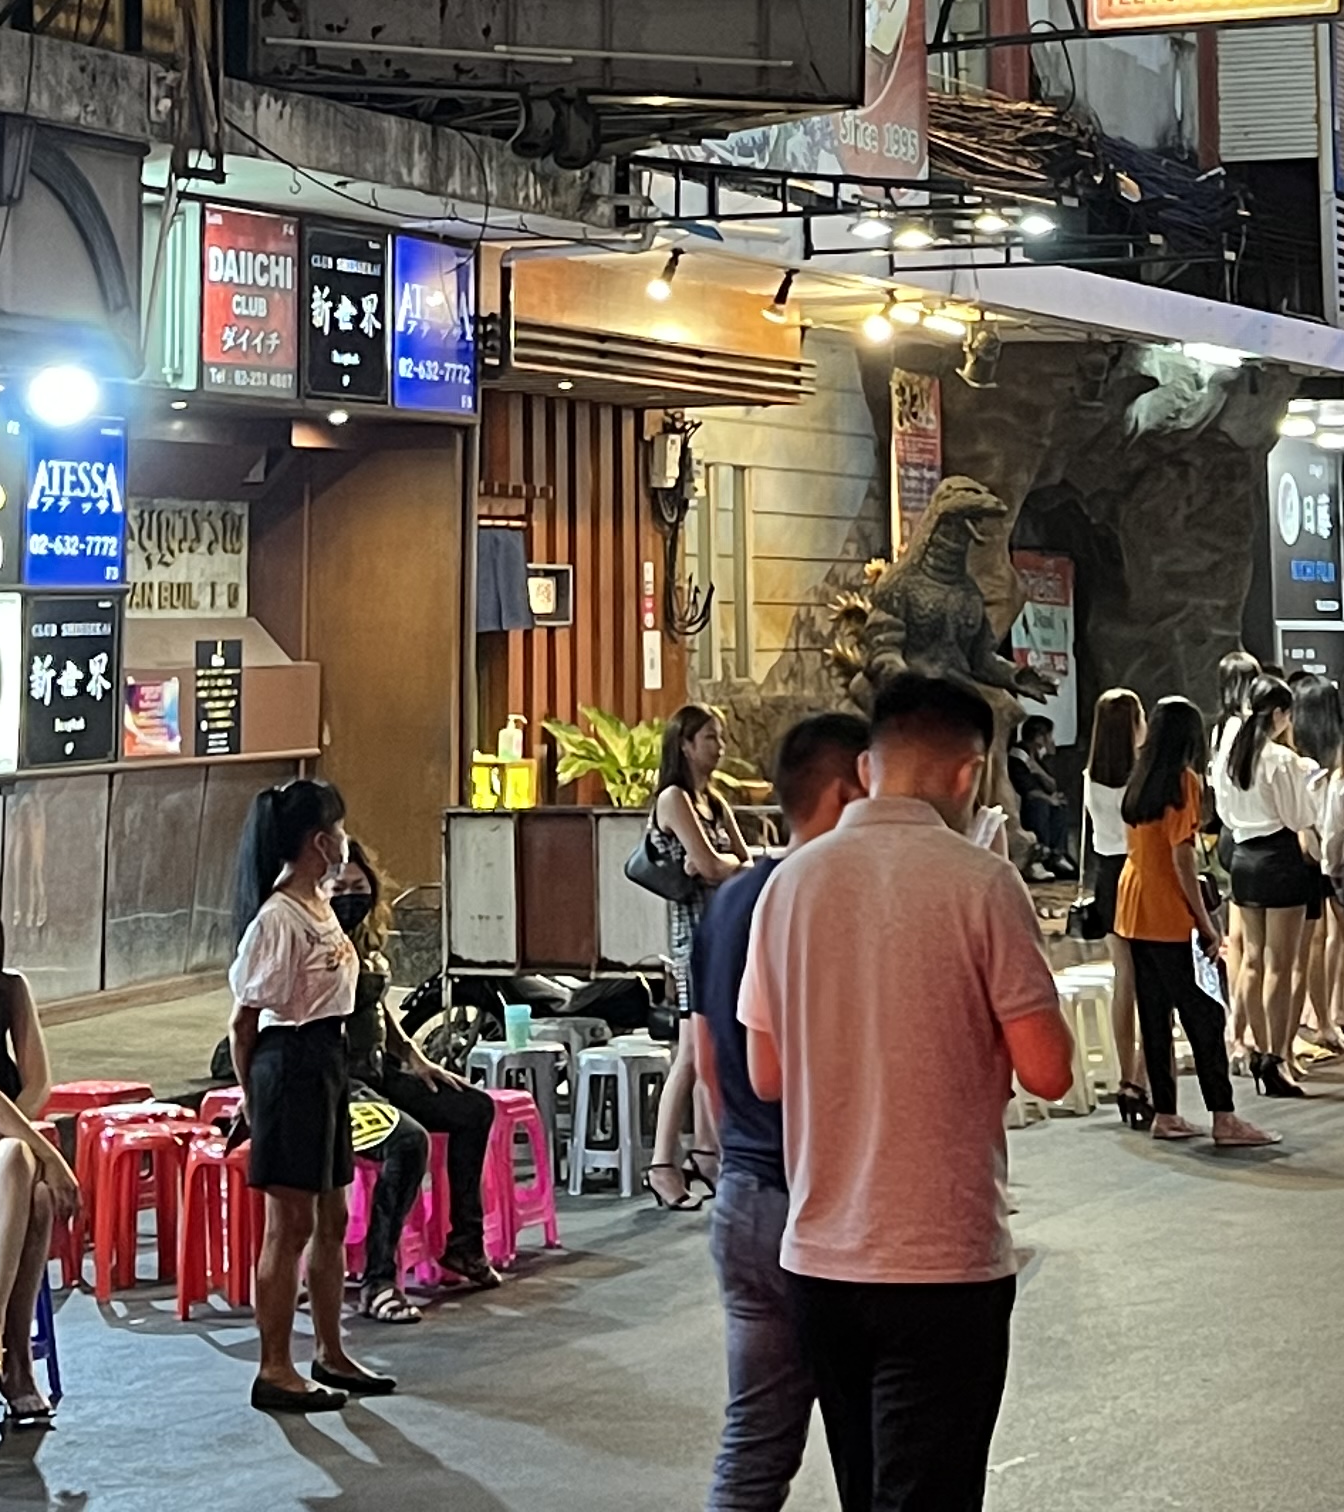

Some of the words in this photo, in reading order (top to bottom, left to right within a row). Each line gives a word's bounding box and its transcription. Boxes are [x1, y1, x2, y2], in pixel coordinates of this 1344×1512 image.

[839, 111, 879, 154] Since
[208, 246, 293, 289] DAIICHI
[232, 294, 268, 318] CLUB
[311, 285, 382, 338] 新世界
[221, 325, 281, 354] ダイイチ
[398, 357, 471, 384] 02-632-7772
[28, 459, 123, 513] ATESSA
[30, 533, 118, 558] 02-632-7772
[30, 652, 112, 707] 新世界
